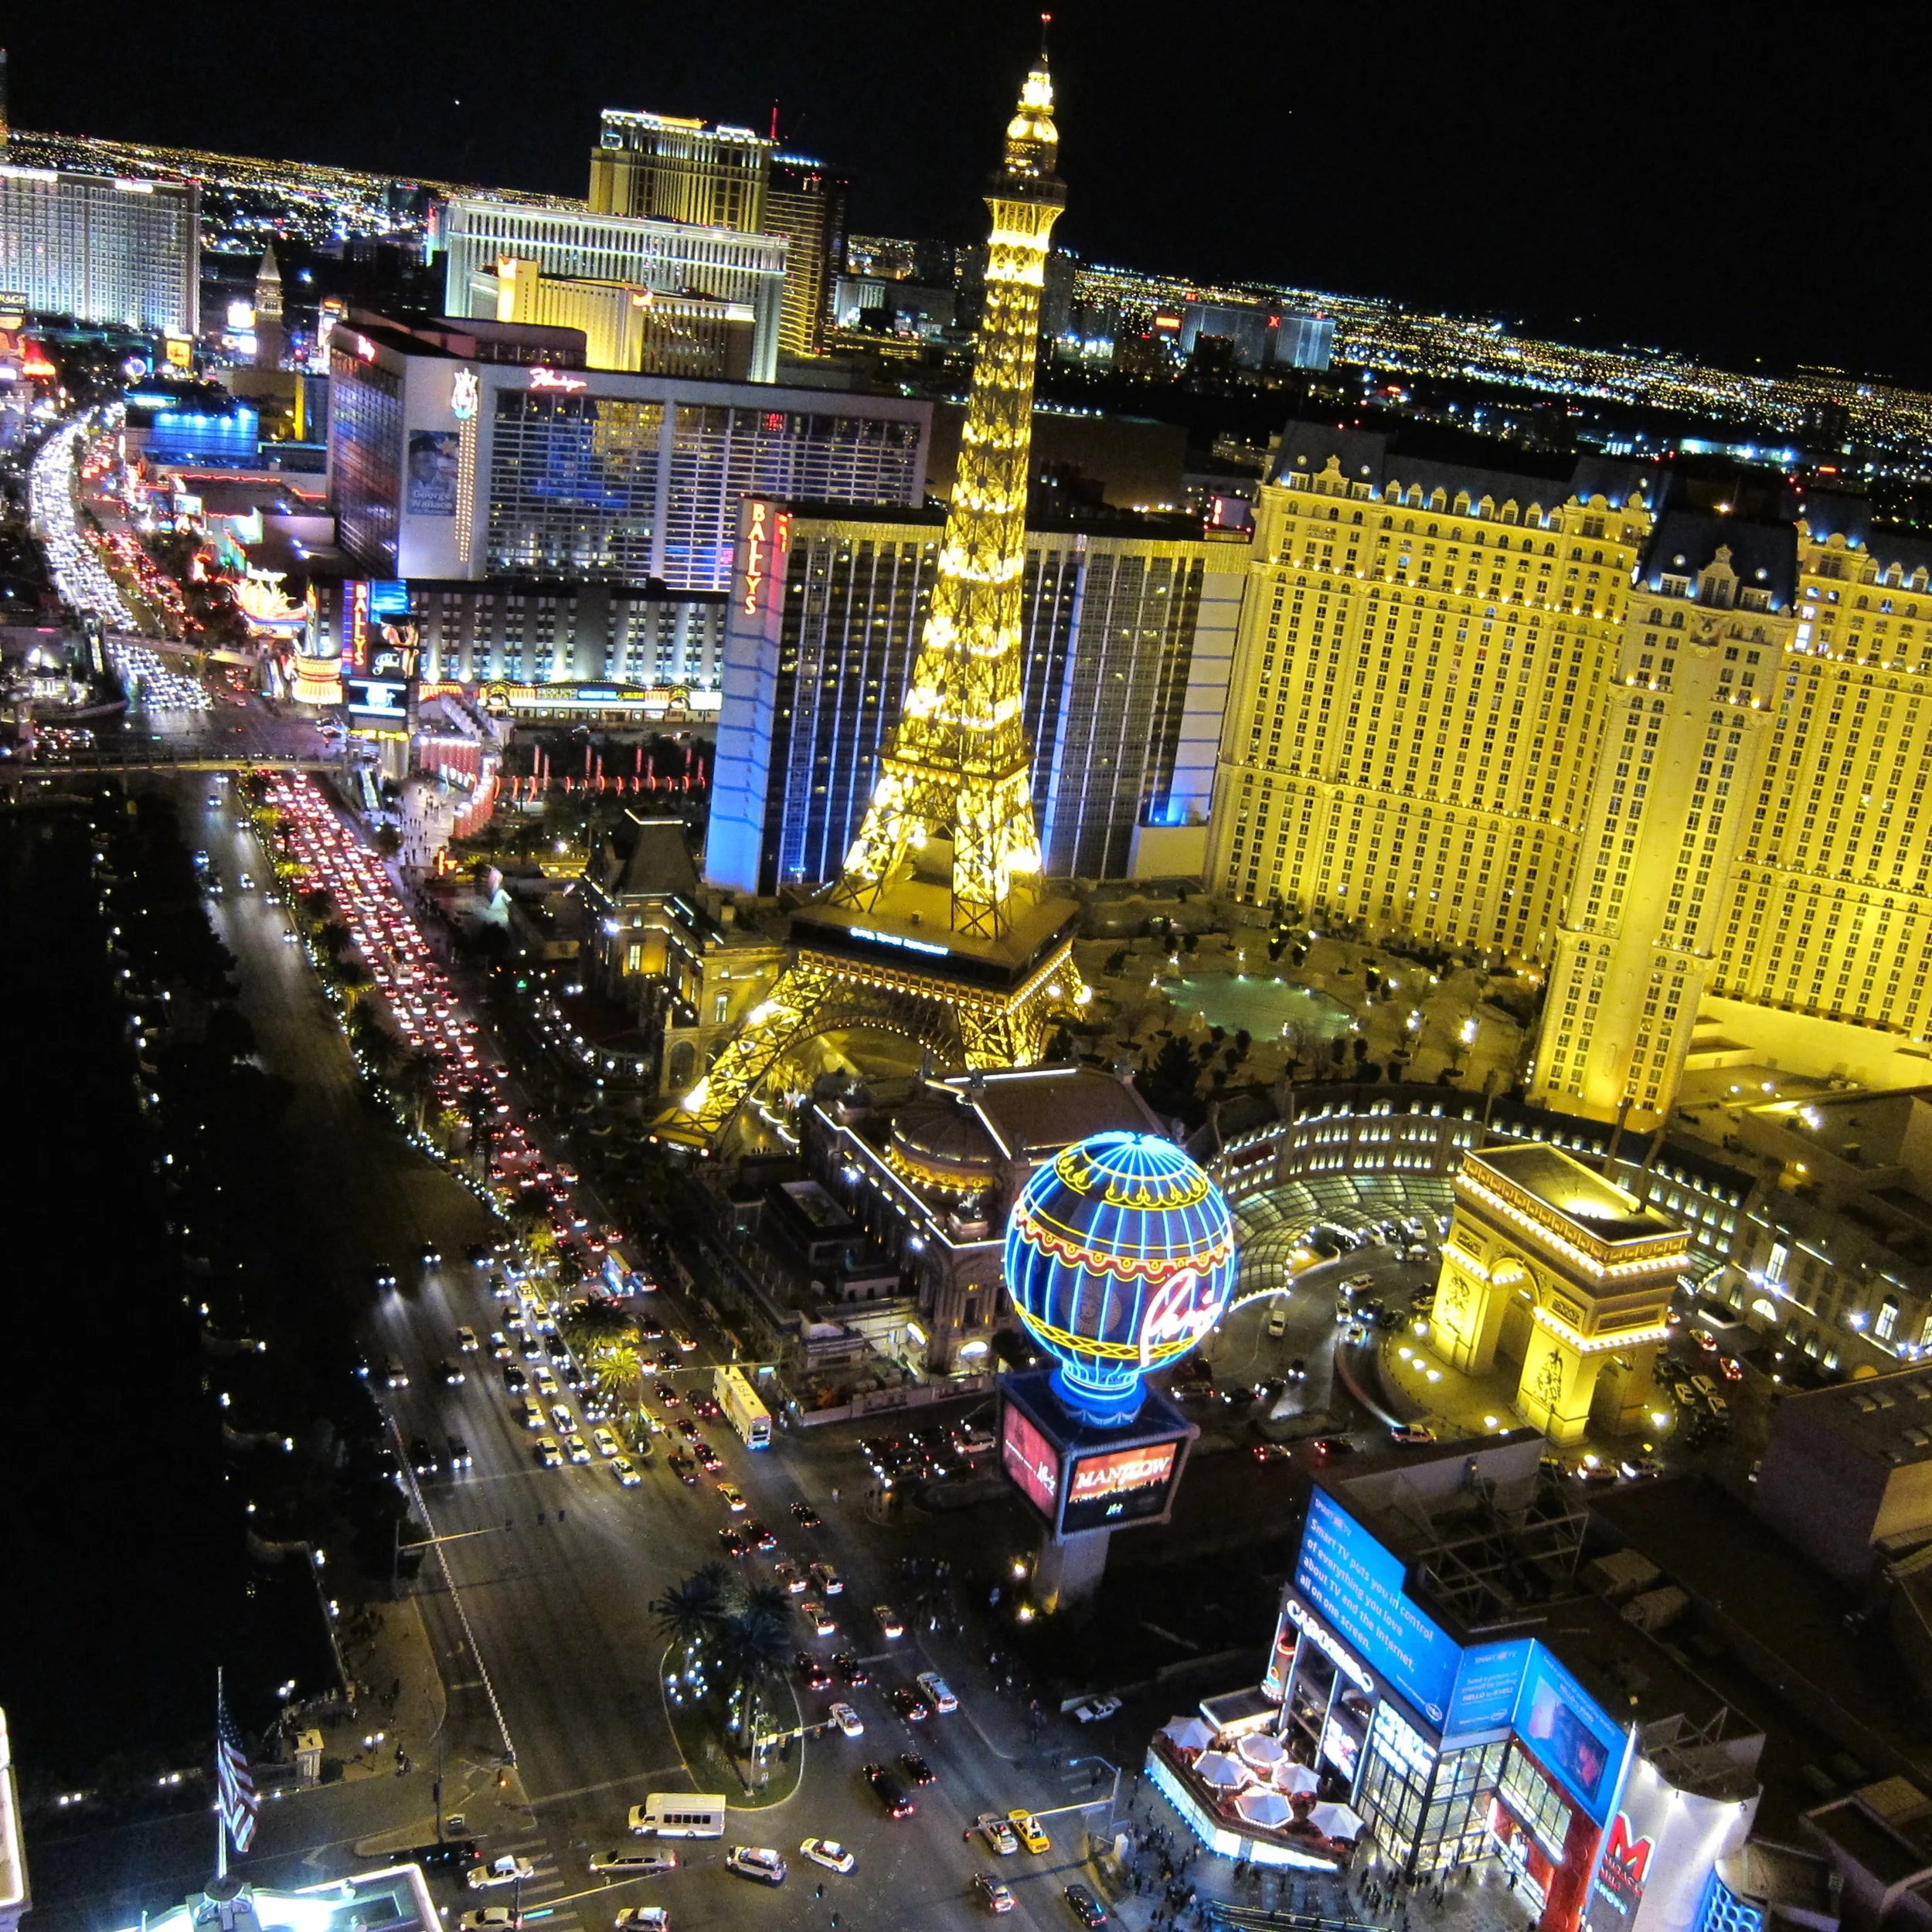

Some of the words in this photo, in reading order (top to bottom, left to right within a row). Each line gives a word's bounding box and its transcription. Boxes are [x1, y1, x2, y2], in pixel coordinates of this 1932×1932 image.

[1140, 1267, 1223, 1367] Paris
[1076, 1456, 1171, 1490] MANILOW
[1299, 1573, 1311, 1590] all
[1311, 1585, 1323, 1602] on
[1323, 1597, 1340, 1619] one
[1303, 1556, 1328, 1586] about
[1329, 1579, 1342, 1597] TV
[1342, 1594, 1359, 1616] and
[1359, 1610, 1375, 1631] the
[1307, 1537, 1318, 1553] of
[1317, 1548, 1365, 1602] everything
[1364, 1595, 1383, 1617] you
[1383, 1610, 1403, 1637] love
[1310, 1519, 1336, 1549] Smart
[1338, 1543, 1349, 1561] TV
[1349, 1557, 1370, 1582] puts
[1370, 1577, 1388, 1599] you
[1389, 1594, 1400, 1610] in
[1400, 1604, 1434, 1641] control
